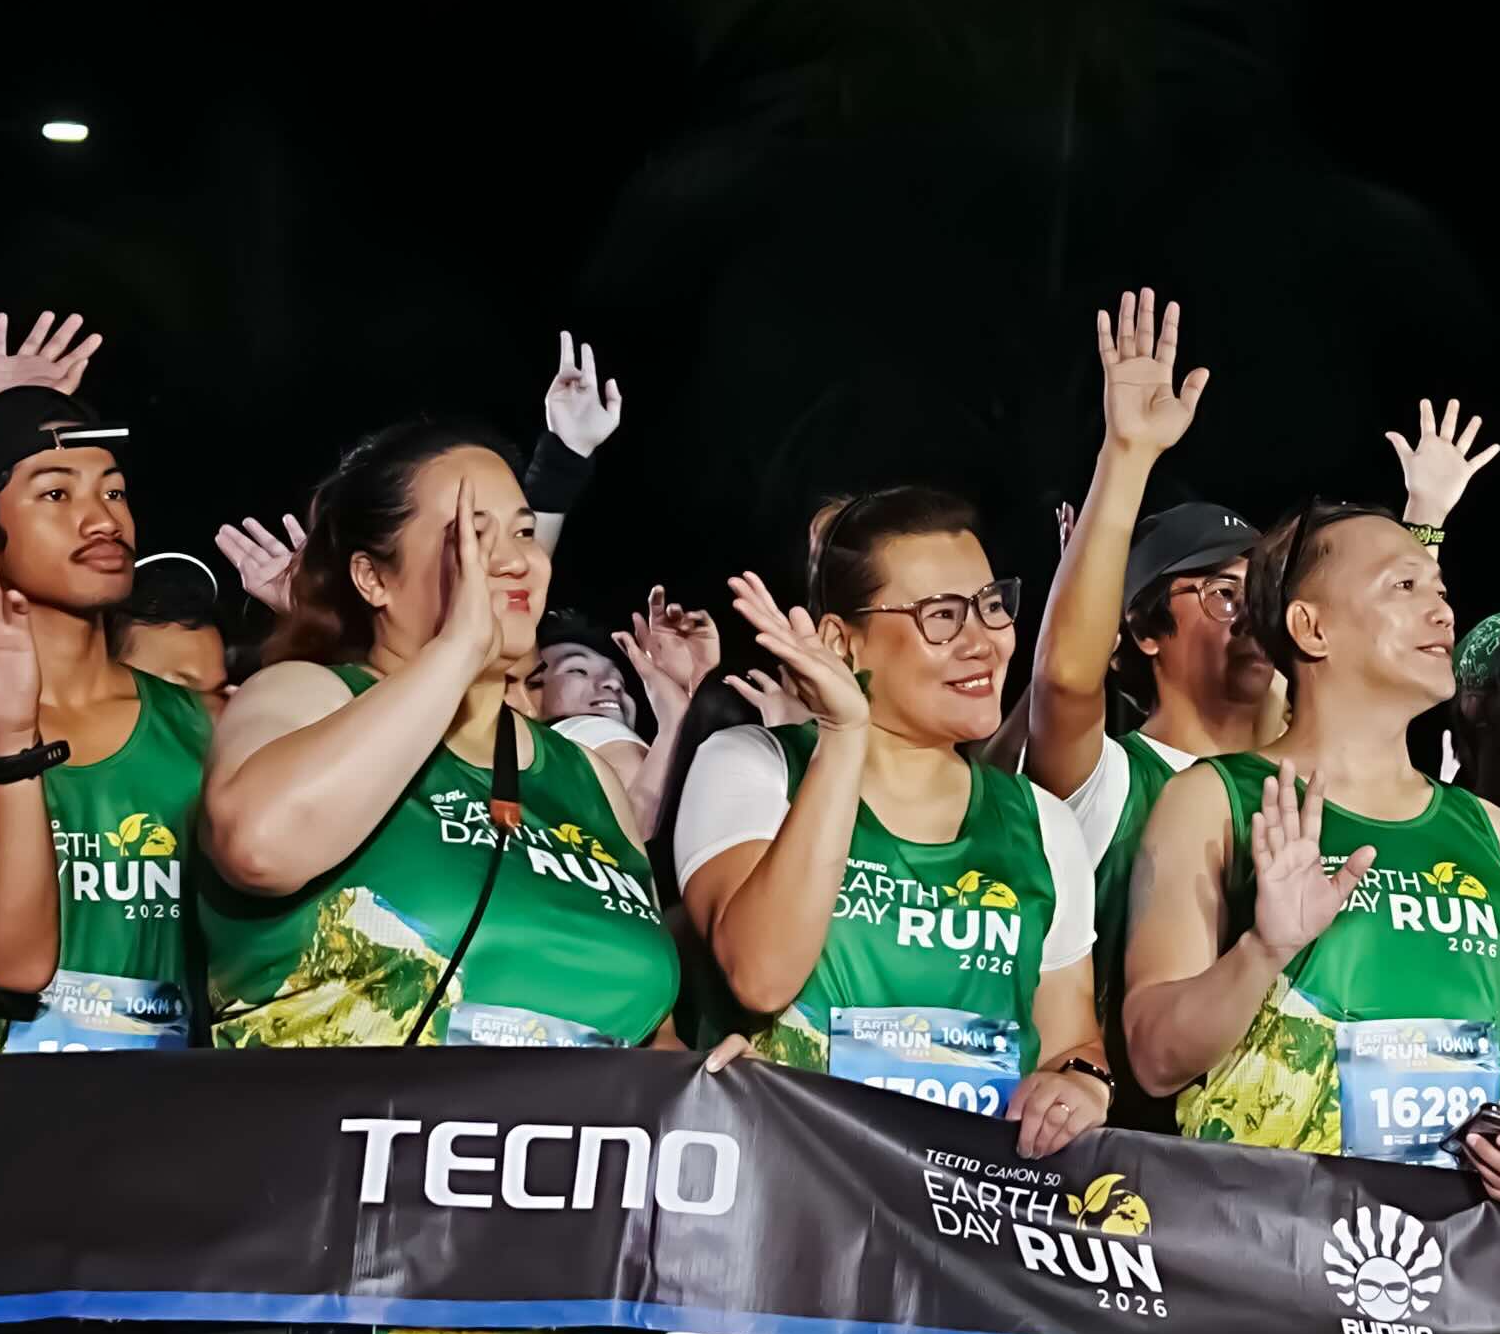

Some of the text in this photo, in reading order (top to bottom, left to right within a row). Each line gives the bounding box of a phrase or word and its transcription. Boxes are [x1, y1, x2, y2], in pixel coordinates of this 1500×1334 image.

[52, 832, 101, 858] RTH
[73, 860, 181, 901] RUN
[527, 845, 651, 907] RUN
[124, 904, 181, 919] 2026
[1389, 894, 1499, 940] RUN
[897, 907, 1021, 956] RUN
[1448, 937, 1497, 957] 2026
[959, 954, 1013, 976] 2026
[62, 1000, 113, 1016] RUN
[125, 996, 170, 1015] 10KM
[852, 1020, 899, 1031] EARTH
[852, 1027, 987, 1050] DAY RUN 10KM
[1383, 1043, 1428, 1060] RUN
[1437, 1037, 1474, 1055] 10KM
[341, 1117, 741, 1216] TECNO
[926, 1148, 1061, 1187] TECNO CAMON 50
[924, 1169, 1058, 1226] EARTH
[932, 1203, 1163, 1293] DAY RUN
[1096, 1289, 1168, 1318] 2026
